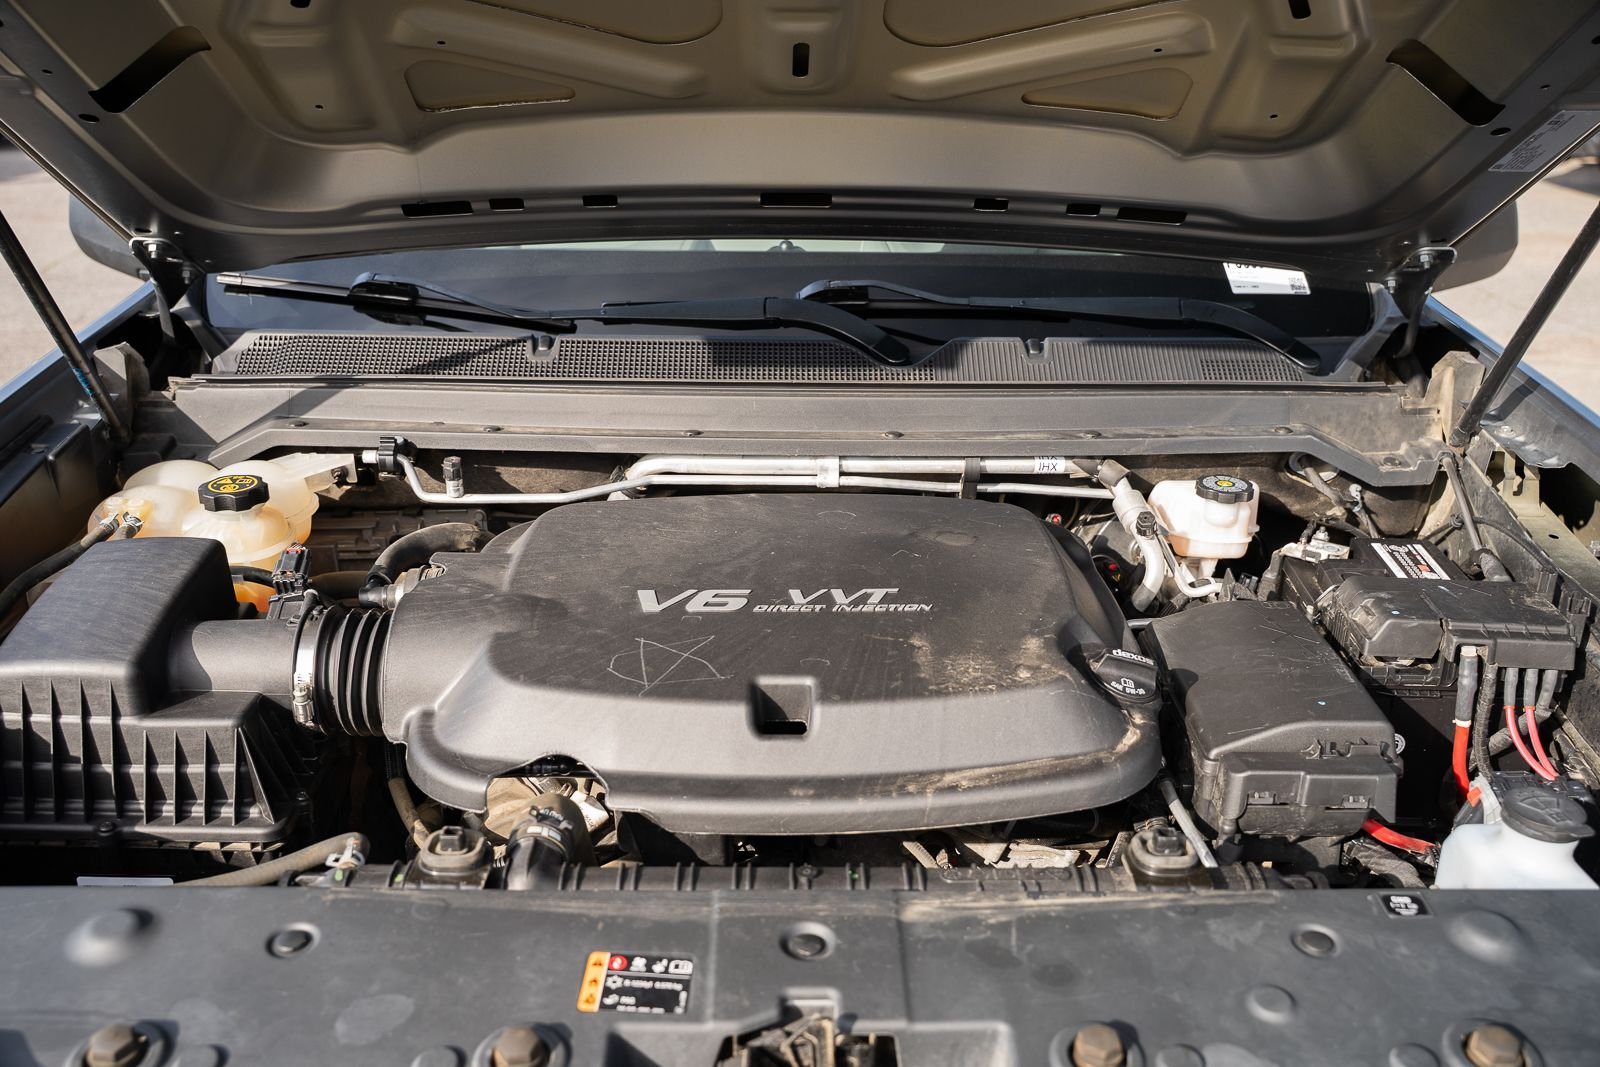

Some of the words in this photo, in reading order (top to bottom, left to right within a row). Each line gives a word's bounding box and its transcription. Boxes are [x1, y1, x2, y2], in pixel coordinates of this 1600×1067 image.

[637, 589, 752, 613] V6
[788, 588, 900, 605] VVT
[752, 604, 827, 613] DIRECT
[831, 603, 934, 613] INJECTION
